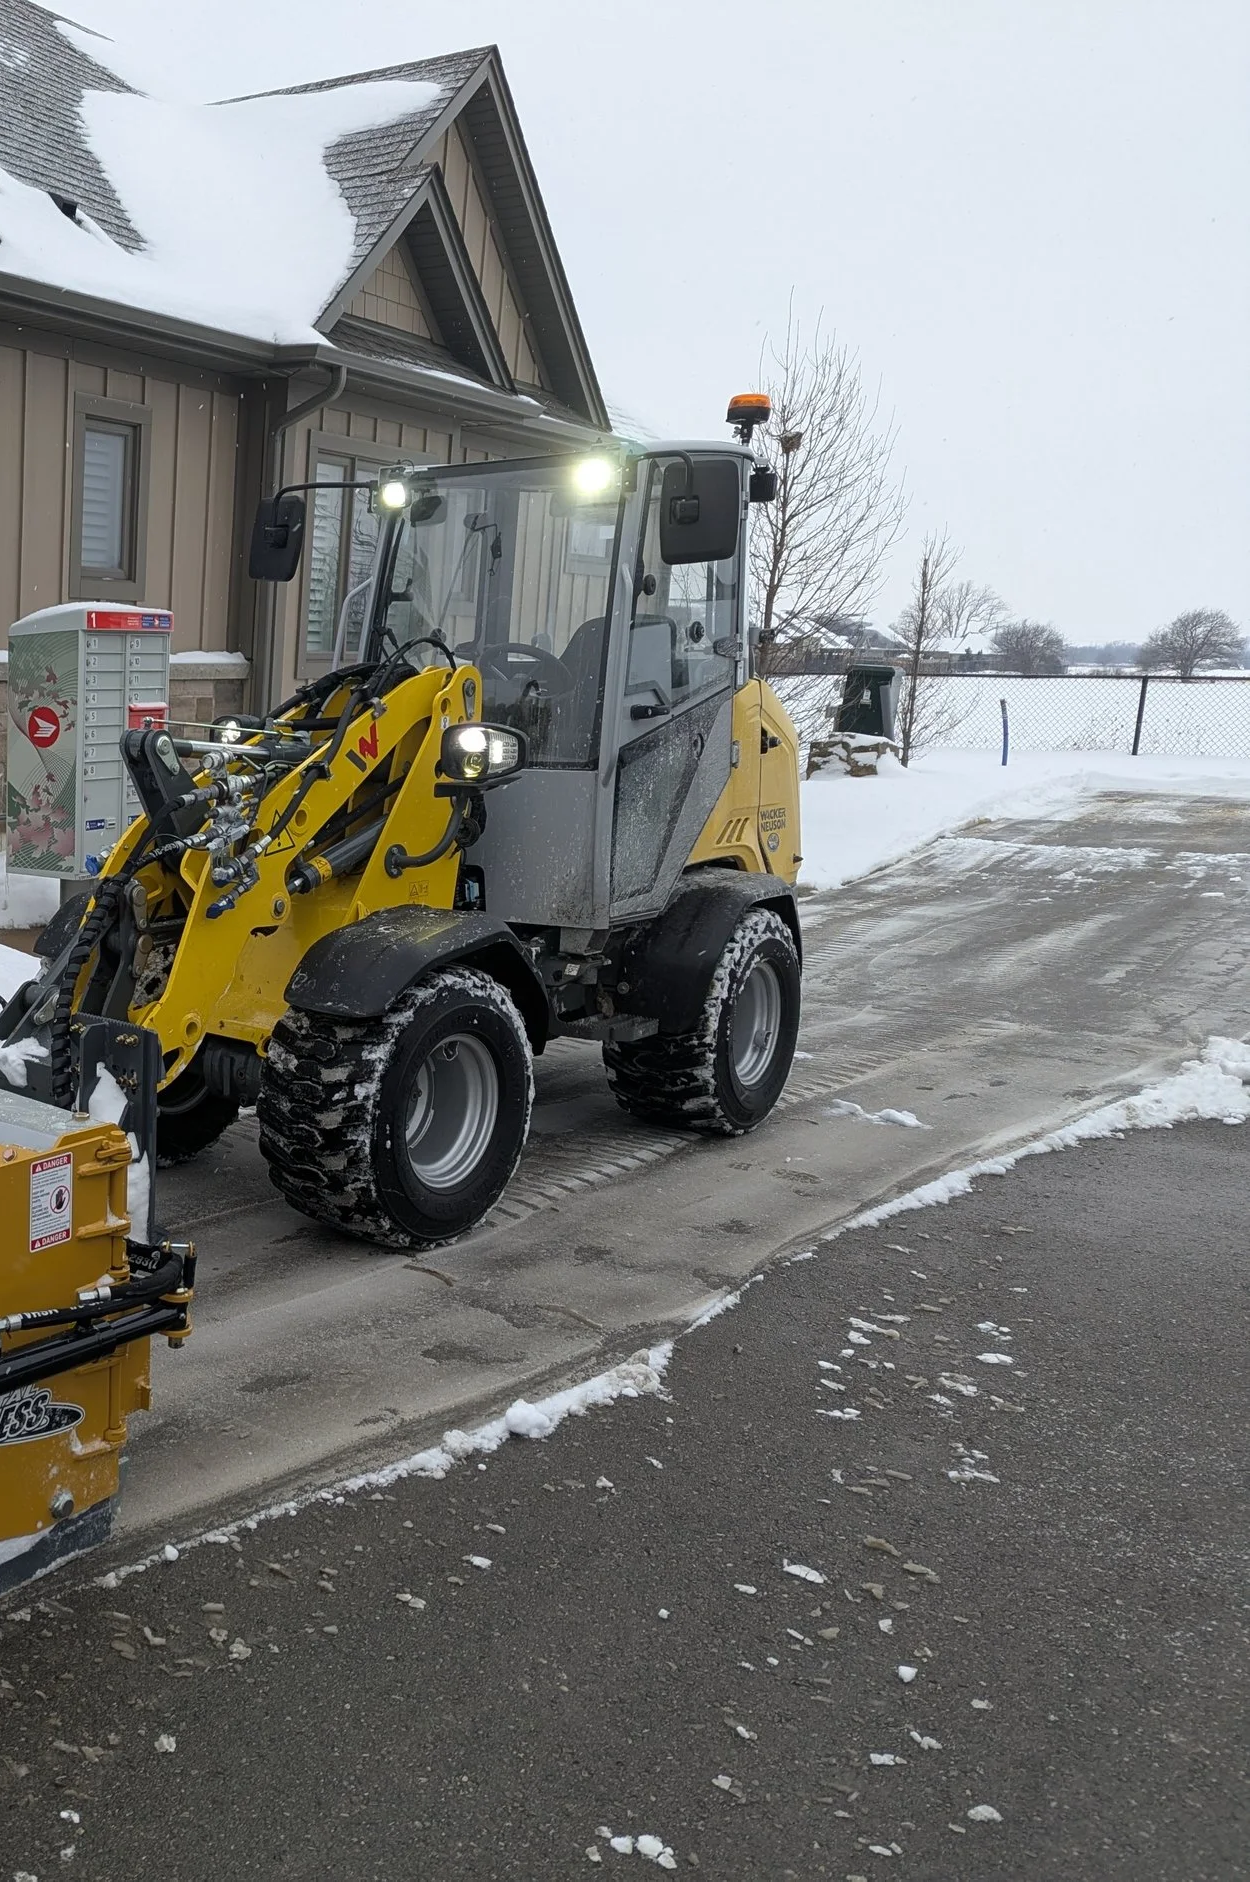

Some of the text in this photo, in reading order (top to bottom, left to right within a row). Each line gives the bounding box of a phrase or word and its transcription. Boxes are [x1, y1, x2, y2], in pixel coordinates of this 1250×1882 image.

[91, 612, 96, 628] 1
[760, 808, 786, 821] WACKER
[760, 819, 786, 832] NEUSON
[42, 1156, 69, 1171] DANGER
[41, 1231, 67, 1246] DANGER
